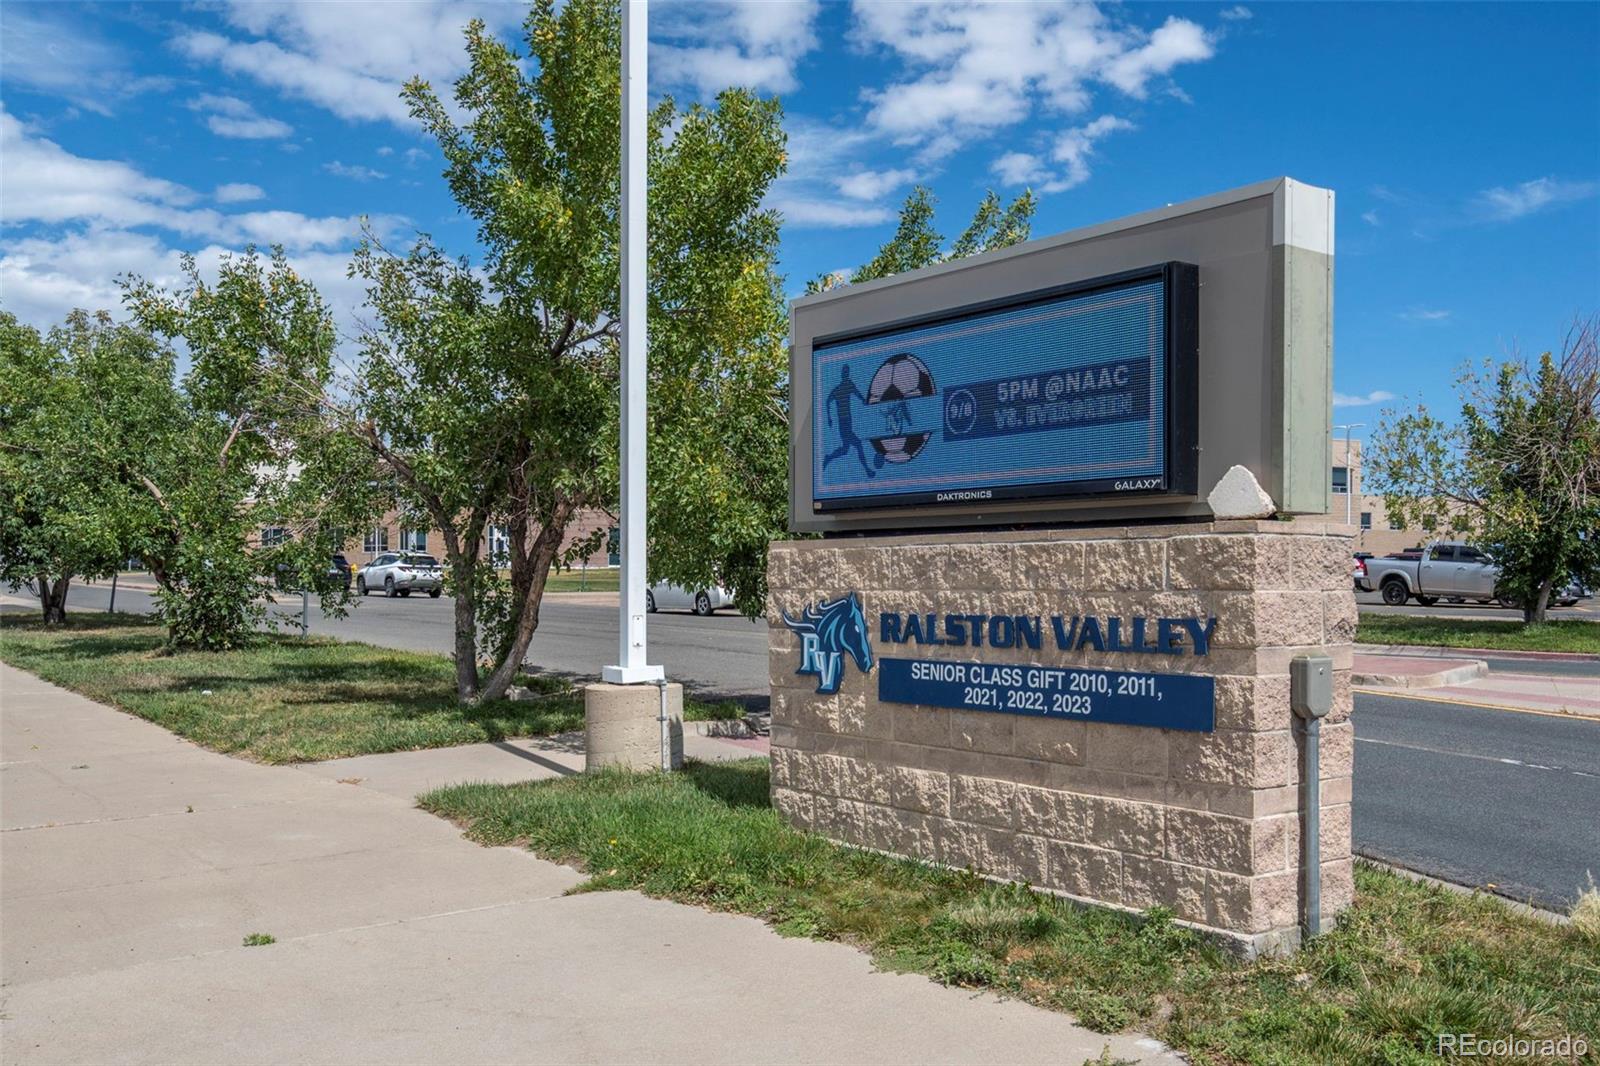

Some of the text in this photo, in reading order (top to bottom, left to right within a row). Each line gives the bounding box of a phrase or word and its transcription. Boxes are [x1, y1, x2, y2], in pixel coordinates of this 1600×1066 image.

[998, 365, 1130, 401] 5PM @NAAC
[937, 490, 993, 501] DAKTRONICS
[1114, 479, 1161, 491] GALAXY
[880, 612, 1217, 656] RALSTON VALLEY
[911, 662, 1163, 701] SENIOR CLASS GIFT 2010, 2011,
[964, 686, 1092, 714] 2021, 2022, 2023
